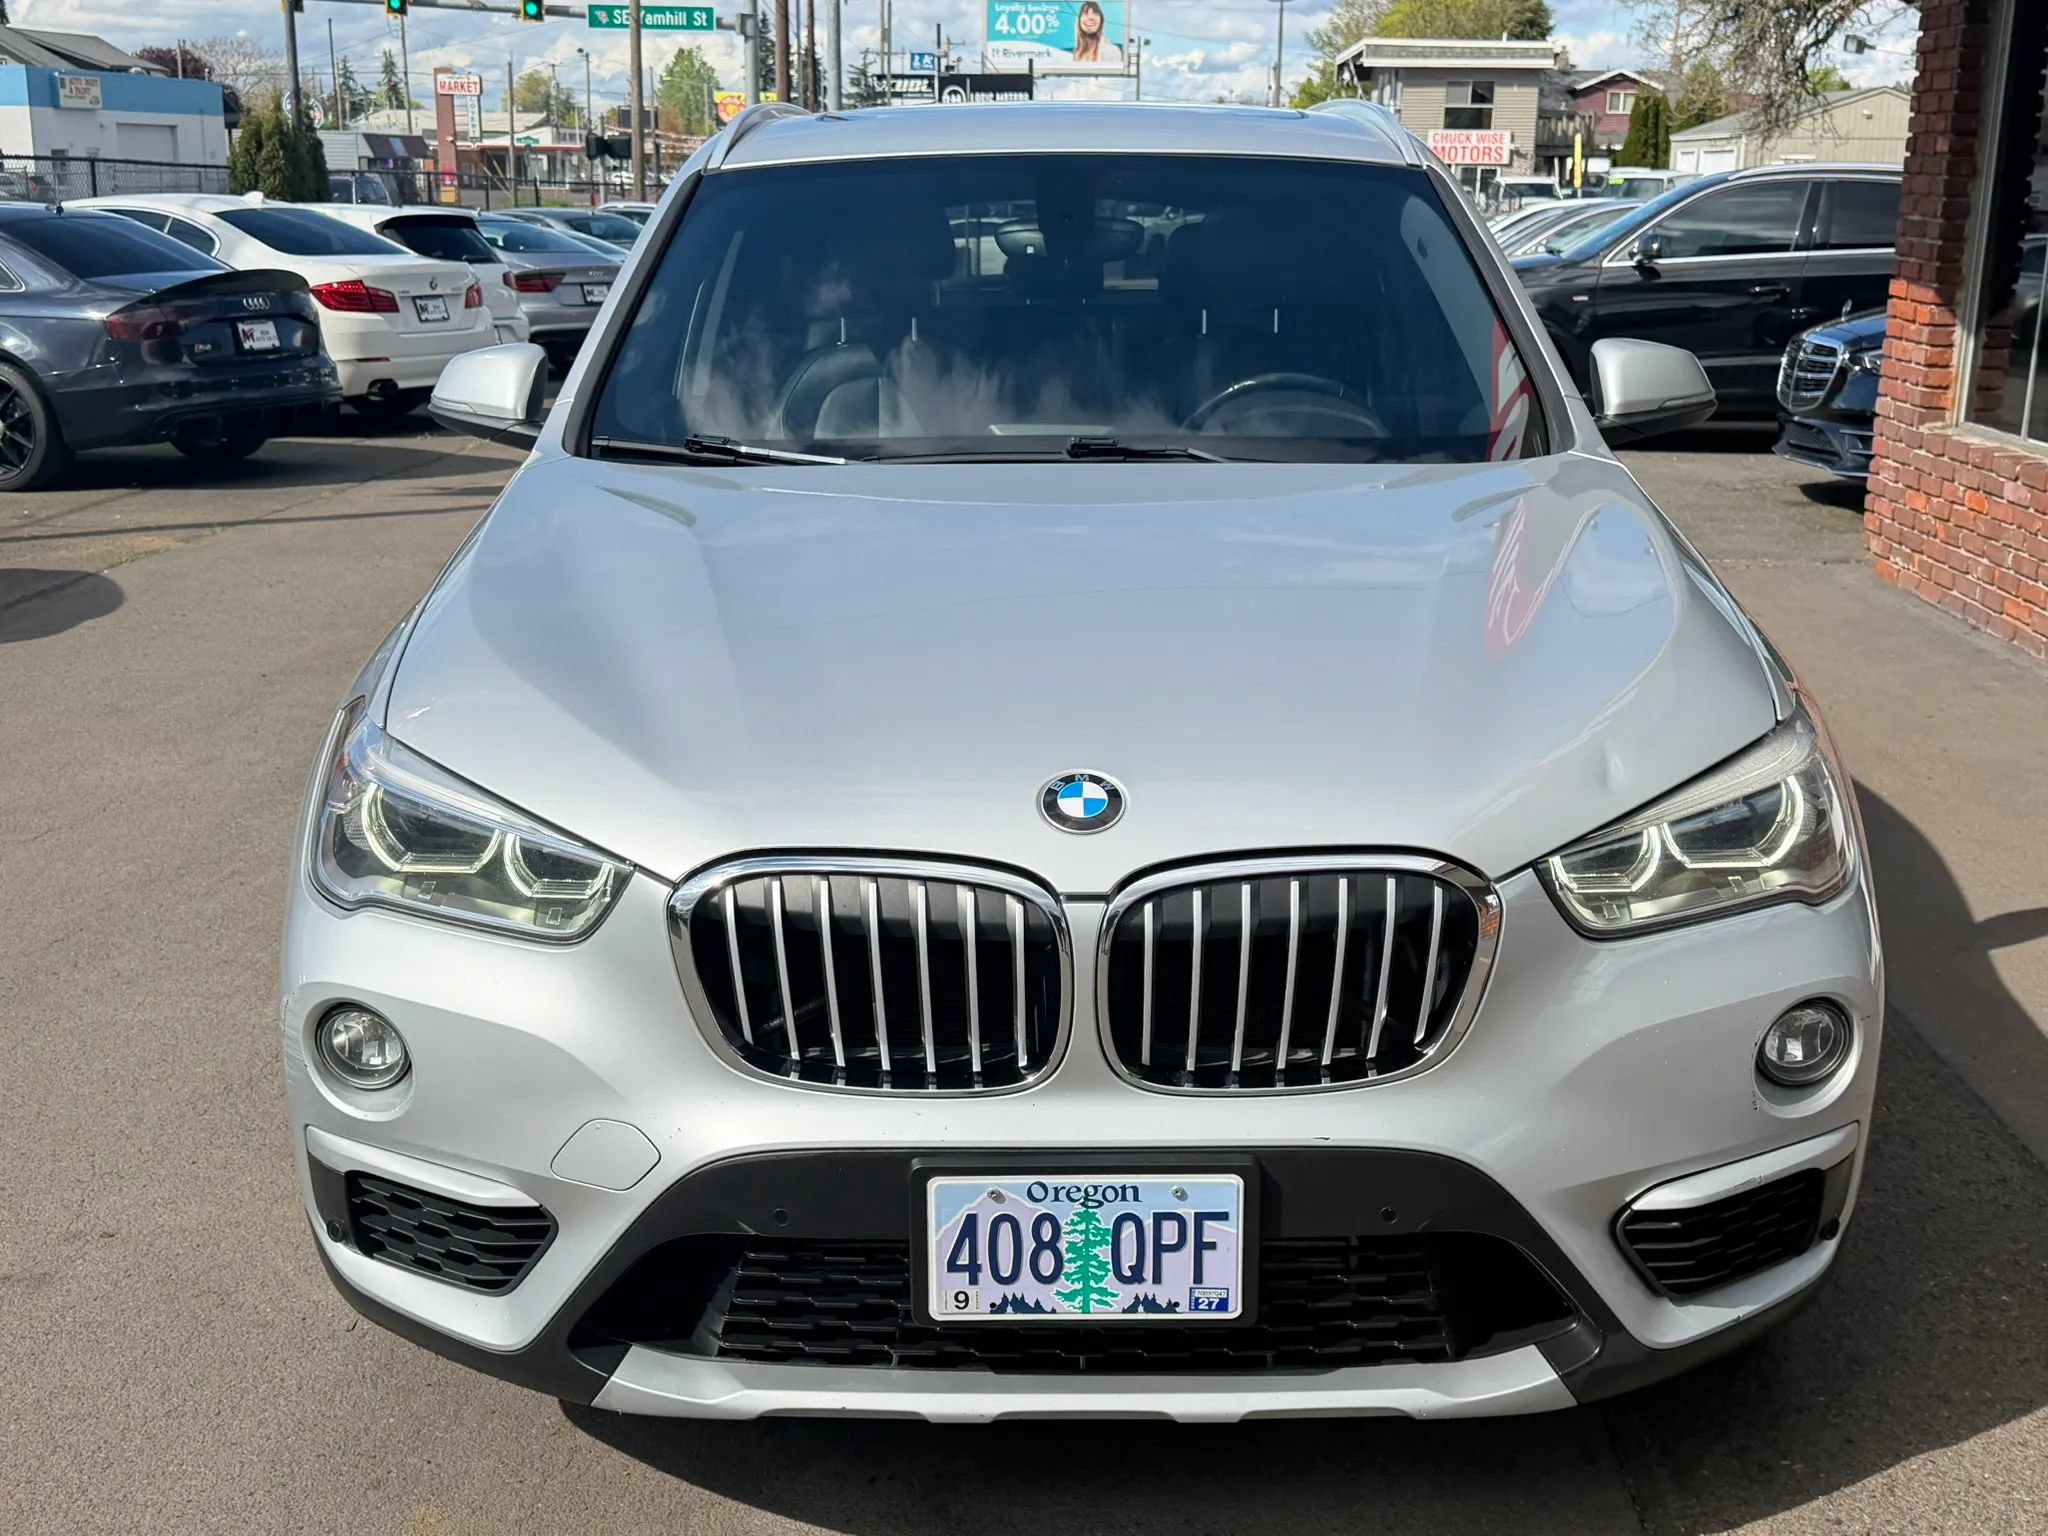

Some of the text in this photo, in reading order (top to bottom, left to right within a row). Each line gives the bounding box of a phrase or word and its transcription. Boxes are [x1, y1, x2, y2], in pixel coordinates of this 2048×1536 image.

[994, 3, 1025, 13] Loyalty
[613, 9, 630, 25] SE
[693, 11, 708, 27] St
[1002, 47, 1052, 58] Rivermark
[440, 80, 479, 94] MARKET
[1433, 132, 1506, 145] CHUCK WISE
[1433, 145, 1504, 163] MOTORS
[1049, 774, 1116, 792] BMW
[1026, 1180, 1144, 1210] Oregon
[946, 1211, 1230, 1286] 408 QPF
[953, 1290, 970, 1310] 9
[1198, 1297, 1220, 1310] 27
